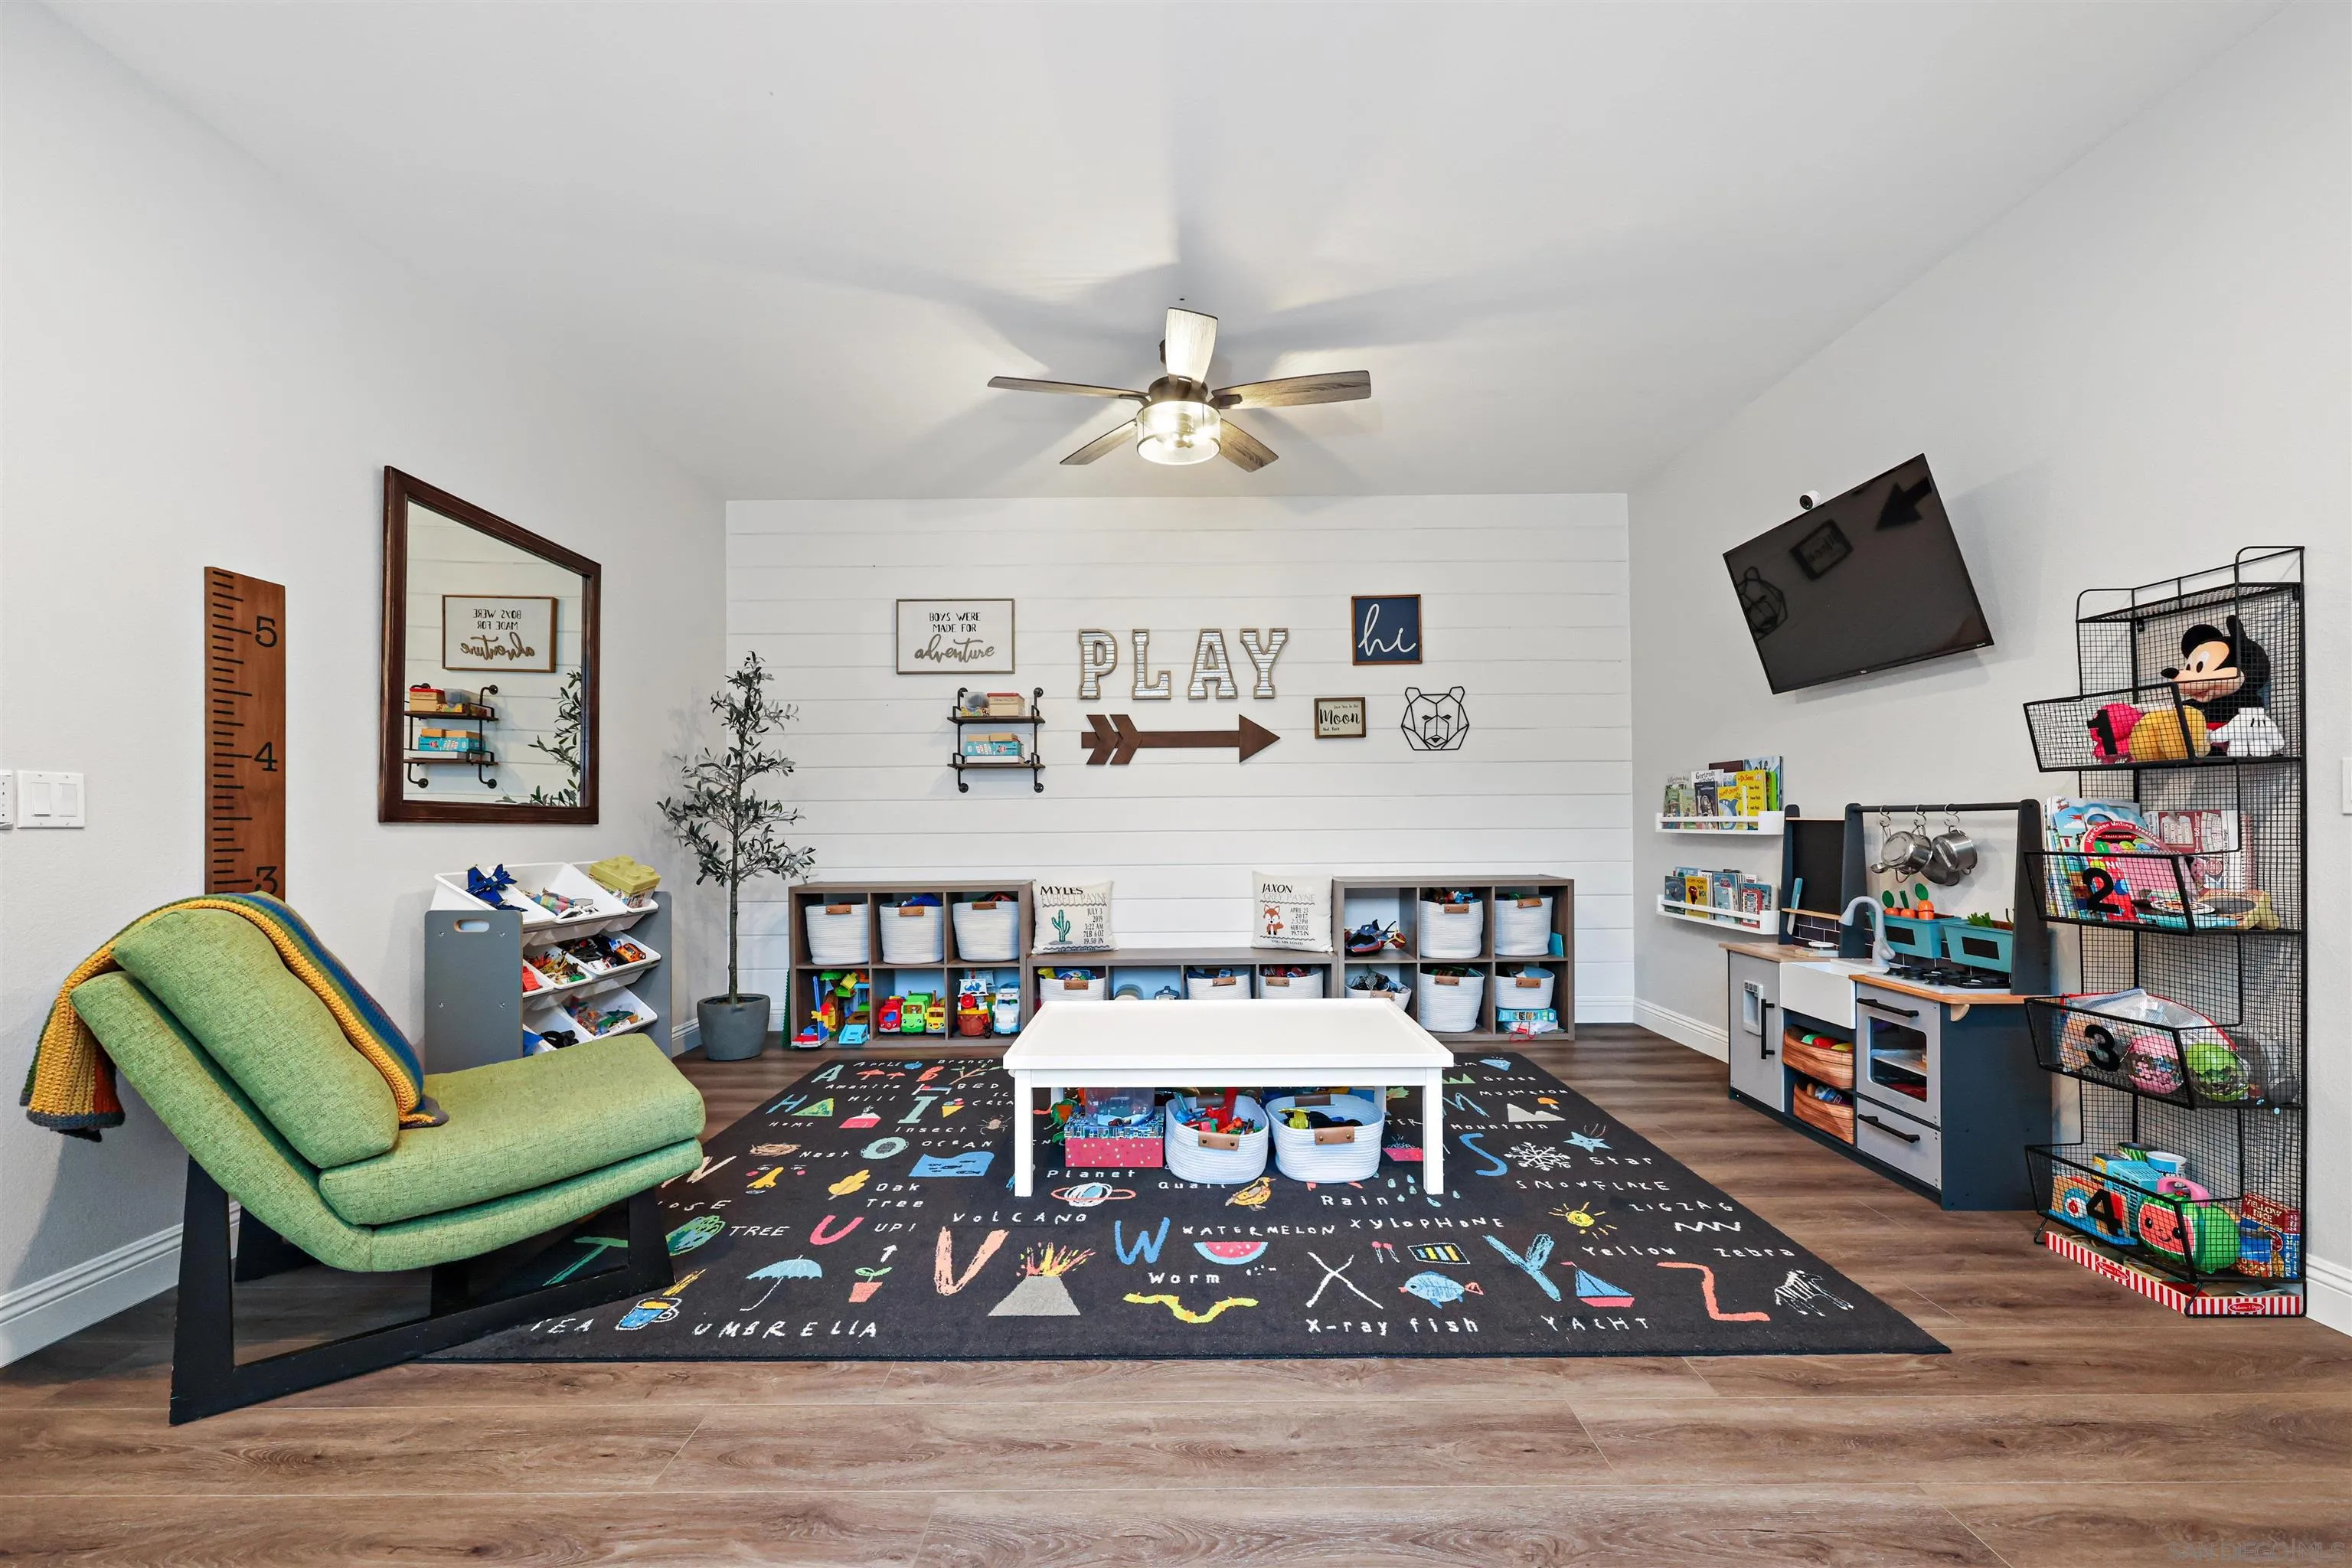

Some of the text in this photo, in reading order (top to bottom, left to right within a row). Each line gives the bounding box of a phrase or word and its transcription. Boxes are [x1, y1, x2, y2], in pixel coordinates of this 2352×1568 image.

[929, 612, 981, 622] BOYS WERE
[255, 616, 278, 648] 5
[933, 623, 977, 632] MADE FOR
[1357, 603, 1416, 656] hi
[914, 633, 995, 663] adventure
[1078, 628, 1289, 700] PLAY
[1319, 708, 1361, 725] Moon
[2087, 709, 2118, 755] 1
[253, 742, 278, 772] 4
[255, 867, 278, 895] 3
[1040, 886, 1083, 895] MYLES
[1262, 883, 1293, 893] JAXON
[2082, 867, 2120, 914] 2
[2084, 1024, 2120, 1072] 3
[811, 1063, 844, 1083] A
[766, 1094, 808, 1114] H
[897, 1096, 939, 1123] I
[1459, 1132, 1509, 1177] S
[1589, 1155, 1654, 1166] Star
[1047, 1170, 1135, 1178] Planet
[875, 1183, 920, 1192] Oak
[658, 1200, 732, 1211] OSE
[866, 1198, 923, 1208] Tree
[1321, 1194, 1389, 1206] Rain
[2086, 1189, 2124, 1236] 4
[730, 1226, 791, 1236] TREE
[809, 1214, 864, 1246] U
[874, 1223, 916, 1232] UP!
[1183, 1225, 1335, 1236] WATERMELON
[1115, 1217, 1171, 1266] W
[1582, 1246, 1677, 1256] Yellow
[934, 1226, 1010, 1296] V
[1713, 1247, 1795, 1257] Zebra
[1482, 1233, 1563, 1302] Y
[1148, 1272, 1220, 1285] Worm
[1305, 1251, 1384, 1309] X
[1305, 1317, 1479, 1336] X-ray fish
